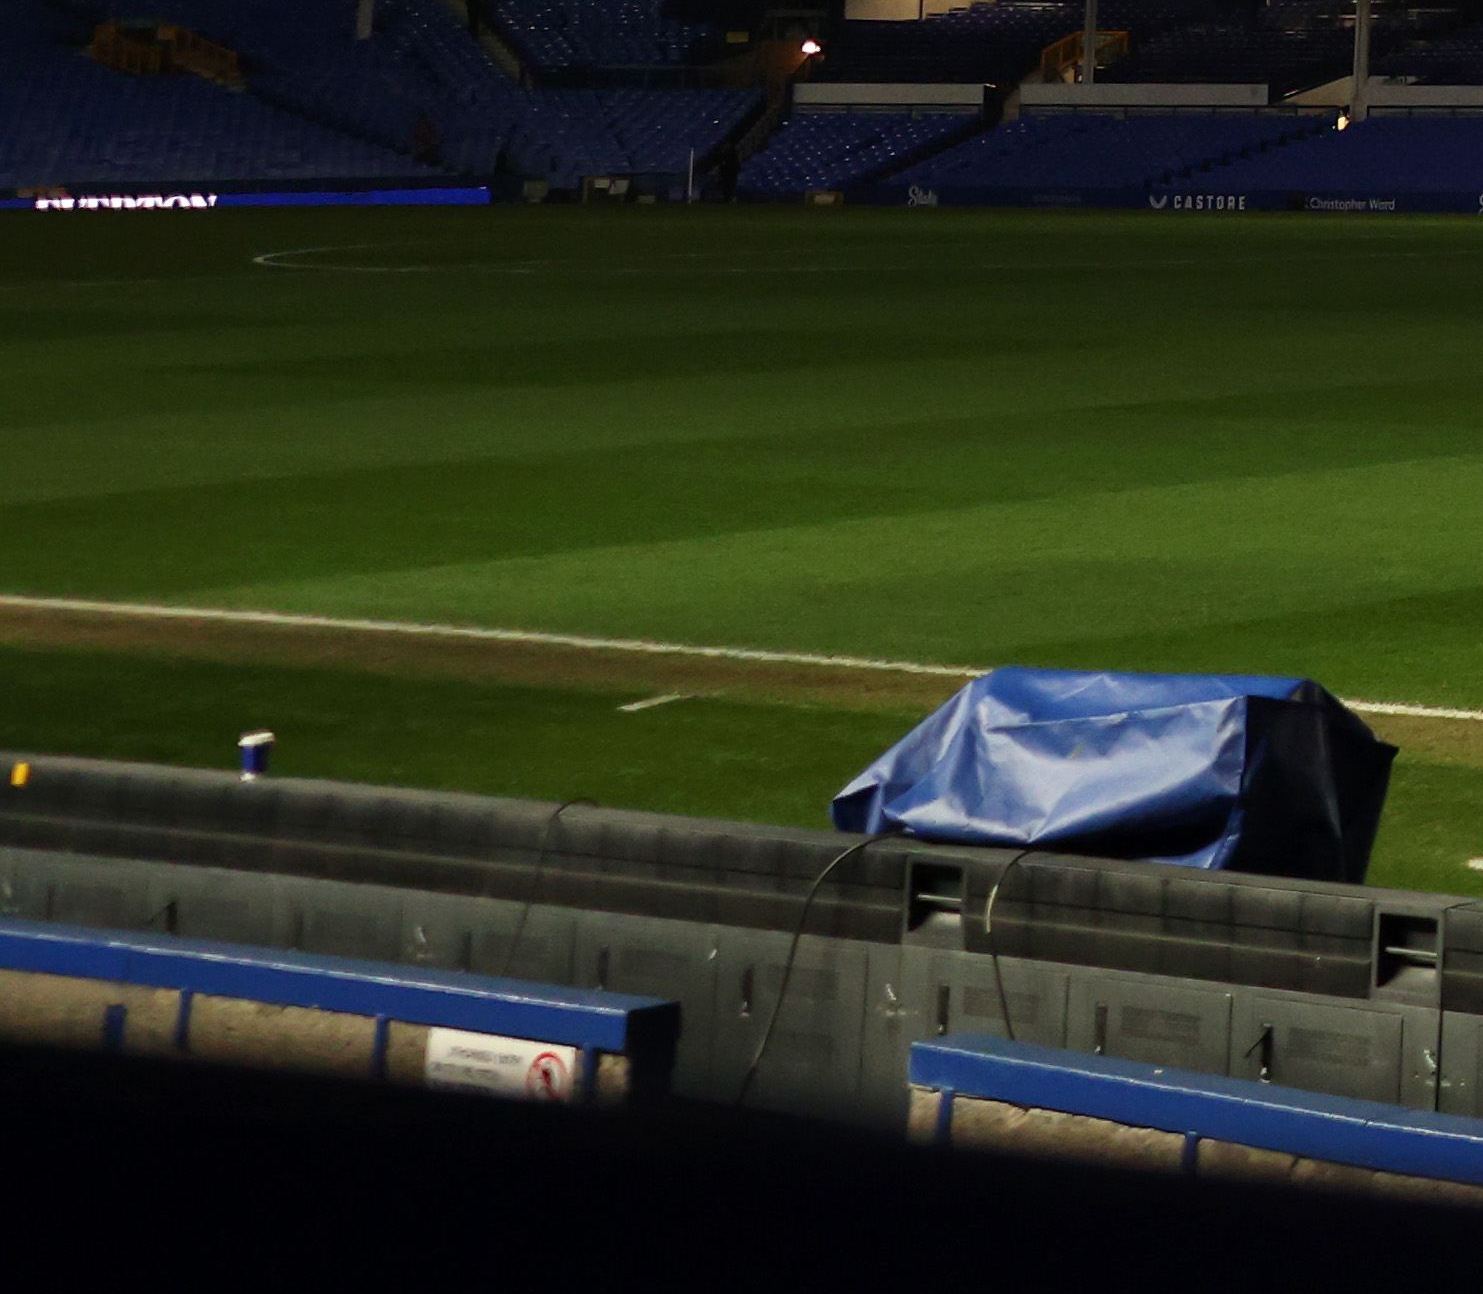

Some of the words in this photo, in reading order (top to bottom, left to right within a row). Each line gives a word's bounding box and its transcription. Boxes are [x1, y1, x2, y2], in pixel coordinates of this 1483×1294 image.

[1173, 194, 1247, 211] CASTORE
[1309, 196, 1366, 213] Christopher
[1369, 197, 1396, 212] Ward
